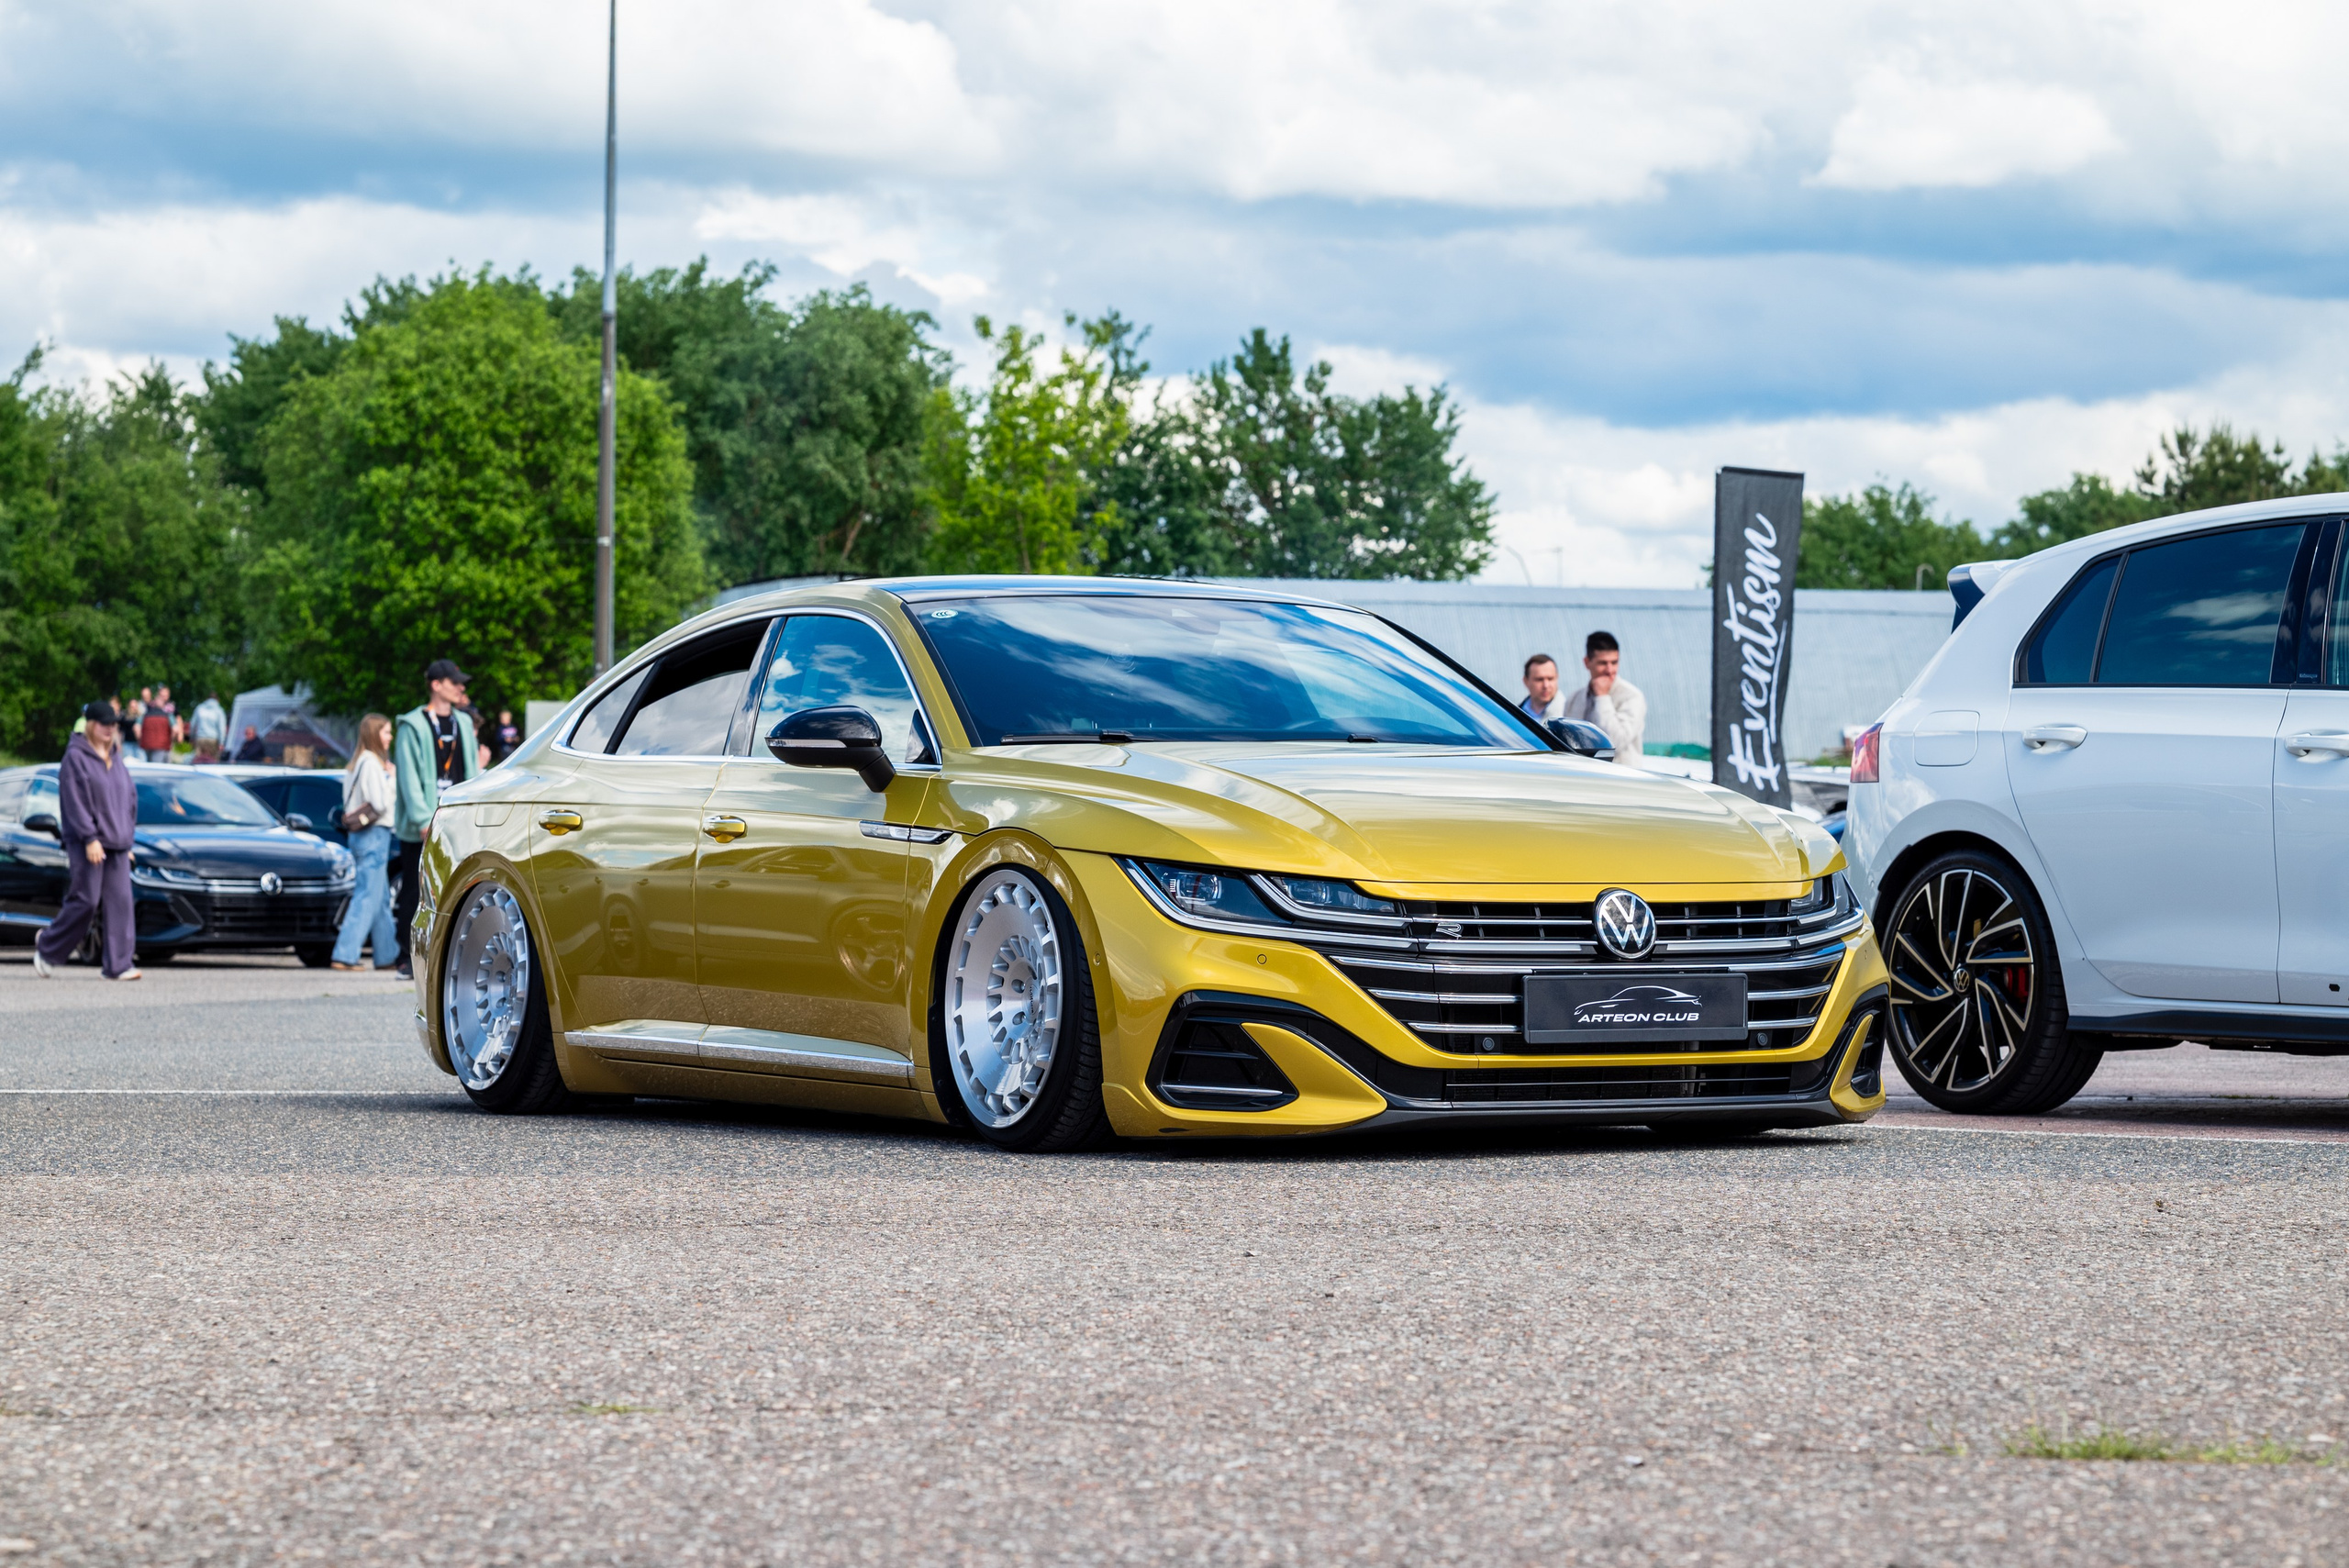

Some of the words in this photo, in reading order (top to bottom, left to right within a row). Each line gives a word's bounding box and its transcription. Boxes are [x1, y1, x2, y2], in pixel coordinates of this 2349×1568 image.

[1723, 513, 1784, 792] Eventism
[1577, 1013, 1650, 1023] ARTEON
[1653, 1012, 1699, 1022] CLUB
